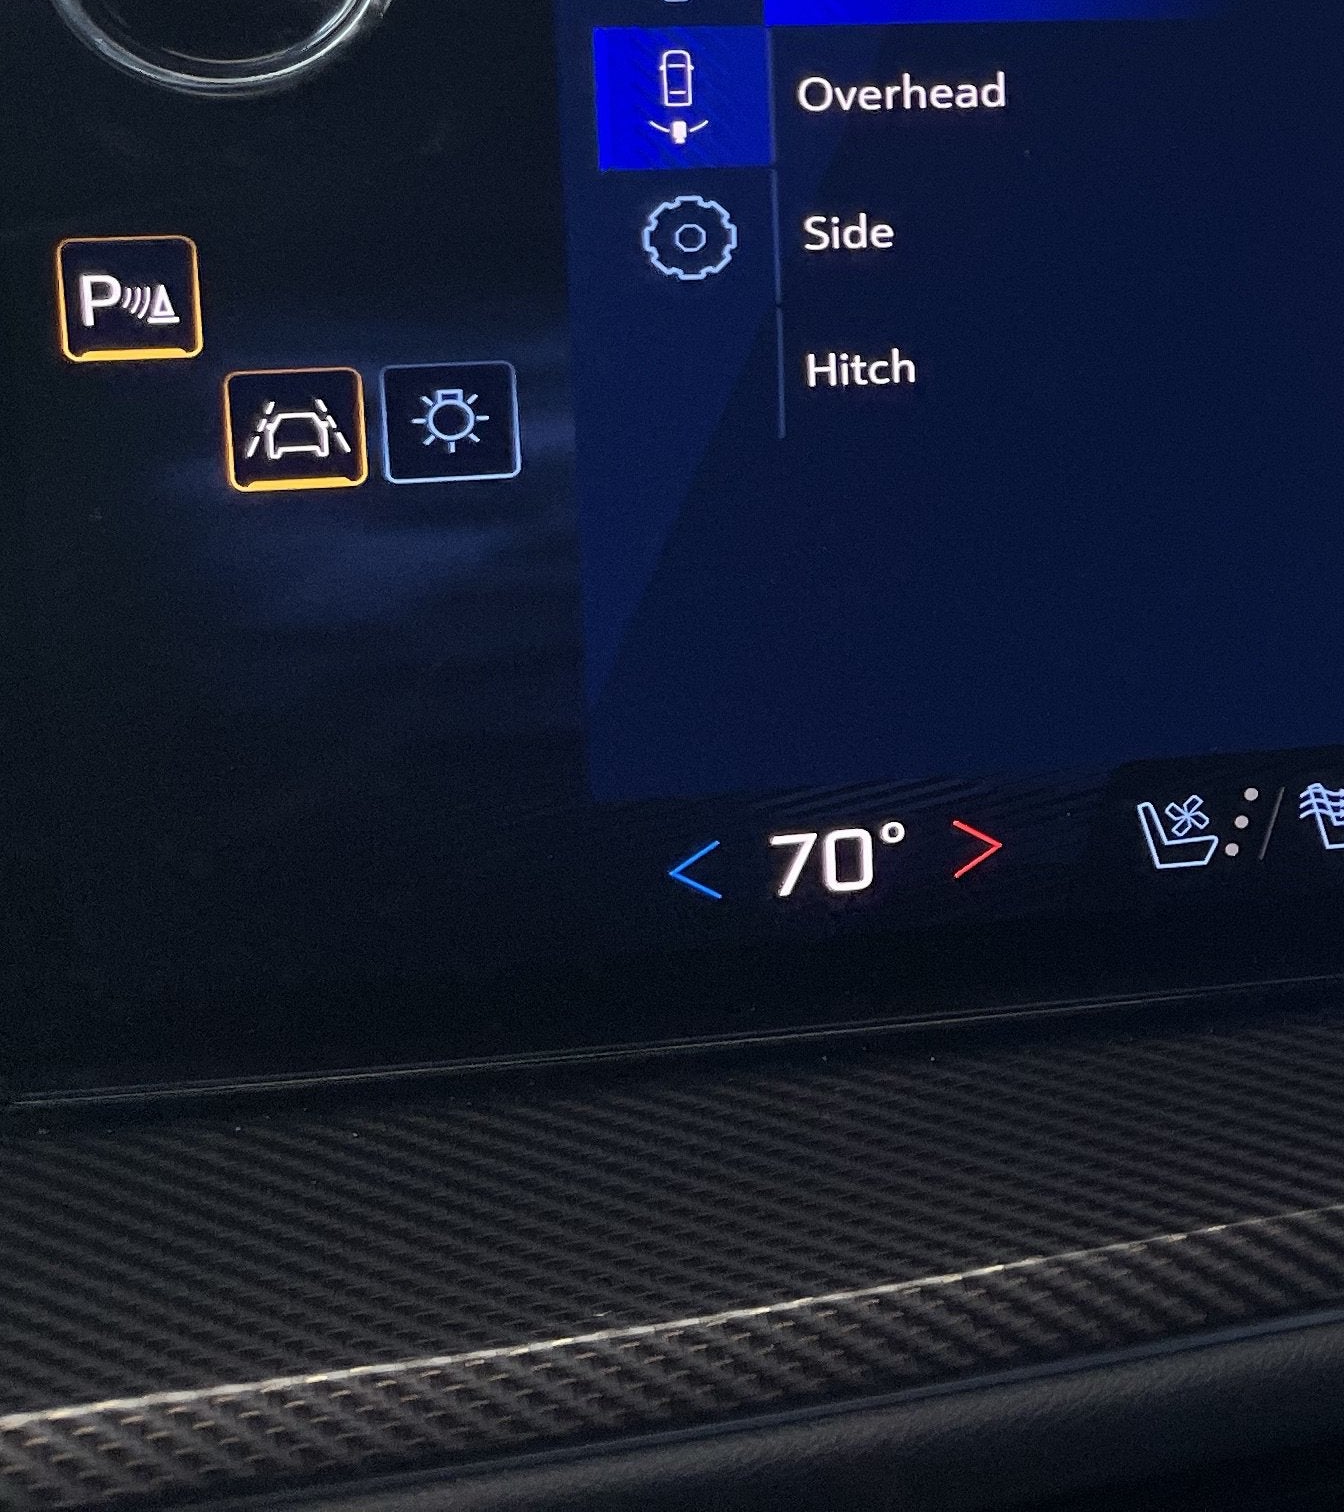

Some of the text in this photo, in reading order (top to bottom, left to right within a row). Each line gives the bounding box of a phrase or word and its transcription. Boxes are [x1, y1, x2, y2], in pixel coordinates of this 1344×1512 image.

[797, 70, 1007, 112] Overhead
[802, 212, 896, 252] Side
[805, 346, 917, 388] Hitch
[769, 819, 907, 898] 70°
